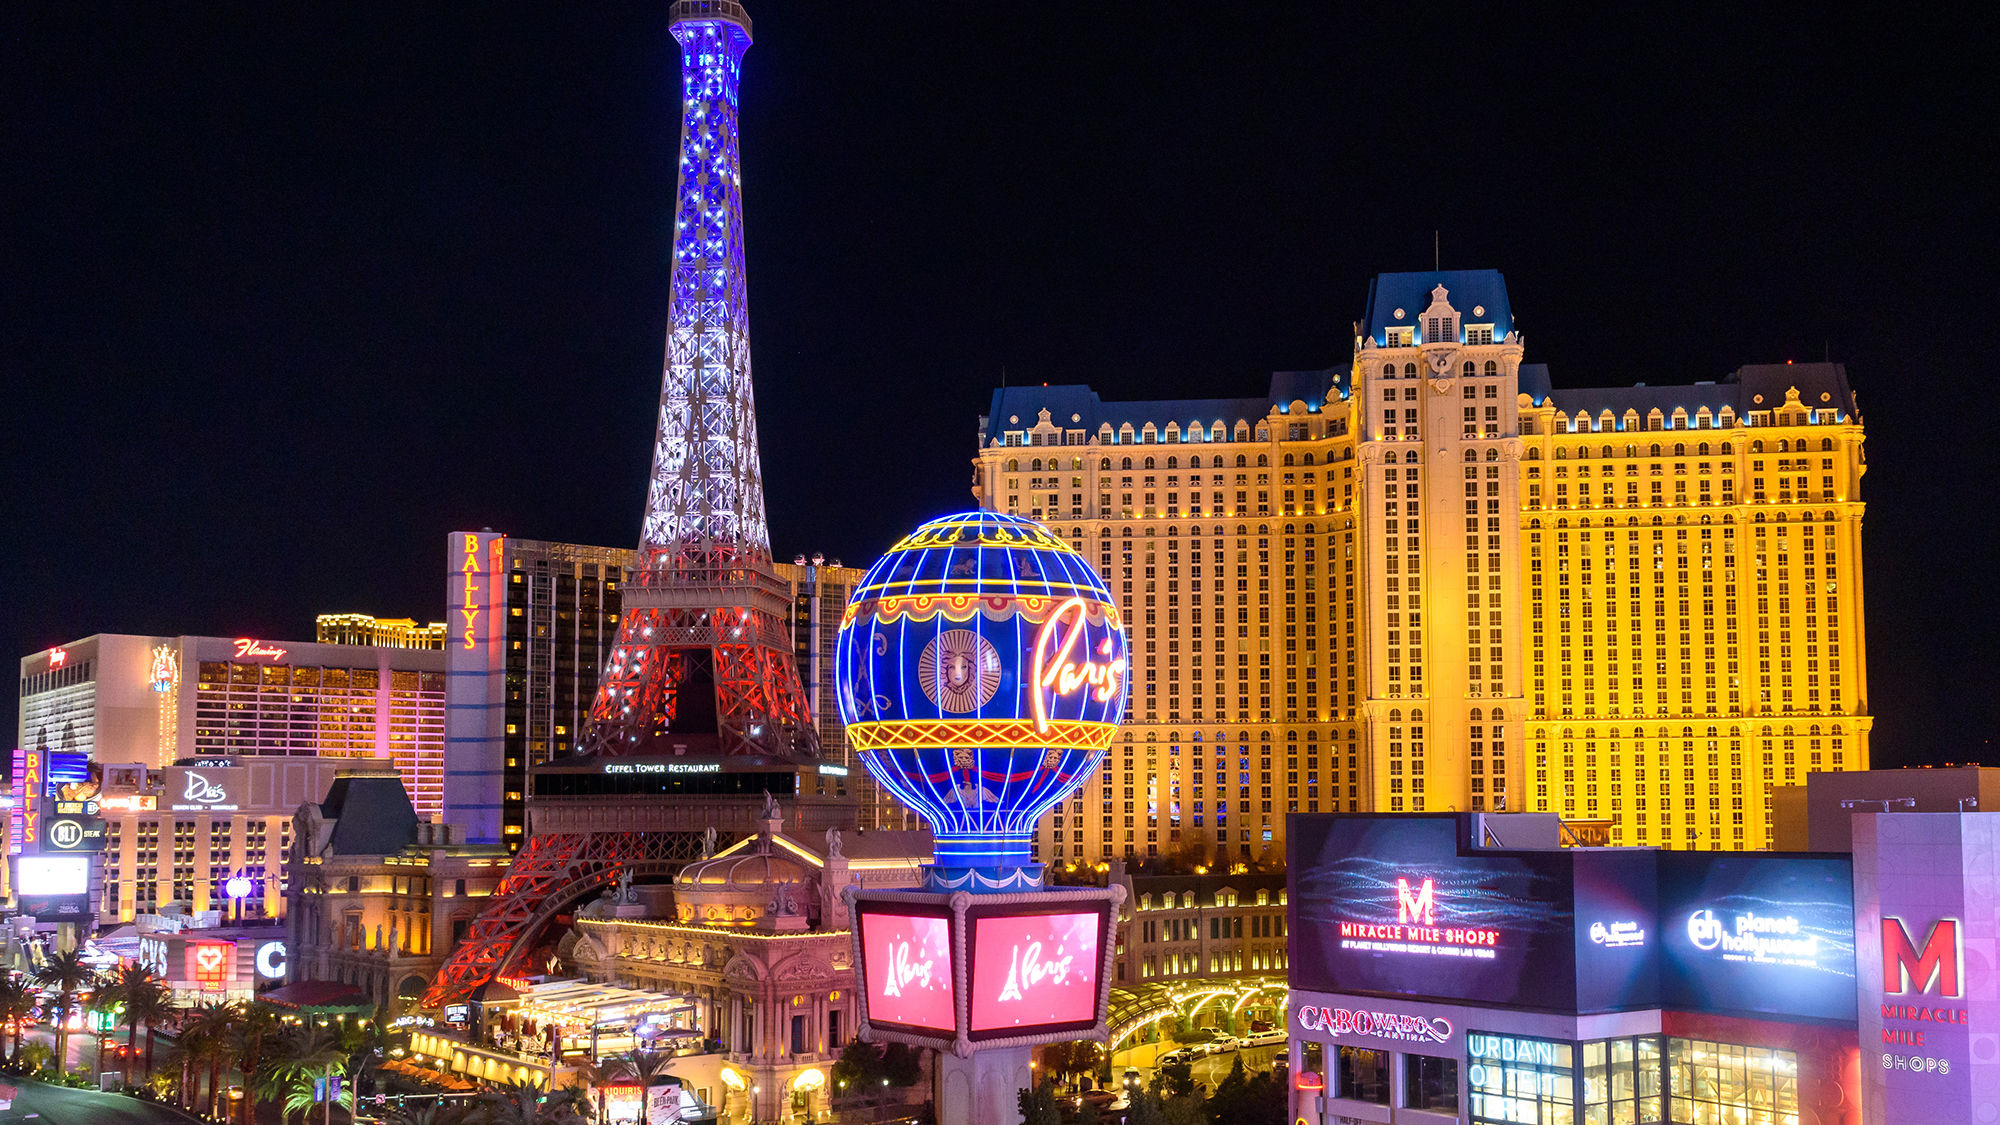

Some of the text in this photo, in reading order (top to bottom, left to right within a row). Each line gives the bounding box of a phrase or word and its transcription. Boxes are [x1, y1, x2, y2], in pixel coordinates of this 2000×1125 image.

[461, 534, 480, 650] BALLYS
[1031, 597, 1126, 734] Paris
[605, 763, 720, 773] EIFFEL TOWER RESTAURANT
[58, 826, 101, 842] BLT STEAK
[1341, 923, 1401, 939] MIRACLE
[1407, 927, 1440, 942] MILE
[1736, 912, 1798, 935] planet
[1722, 931, 1817, 957] hollywood
[139, 937, 168, 977] CVS
[1022, 941, 1073, 990] Paris
[1882, 917, 1961, 998] M
[1881, 1004, 1968, 1025] MIRACLE
[1376, 1031, 1426, 1043] CANTINA
[1881, 1028, 1925, 1046] MILE
[1468, 1034, 1552, 1065] URBAN
[1882, 1053, 1950, 1075] SHOPS
